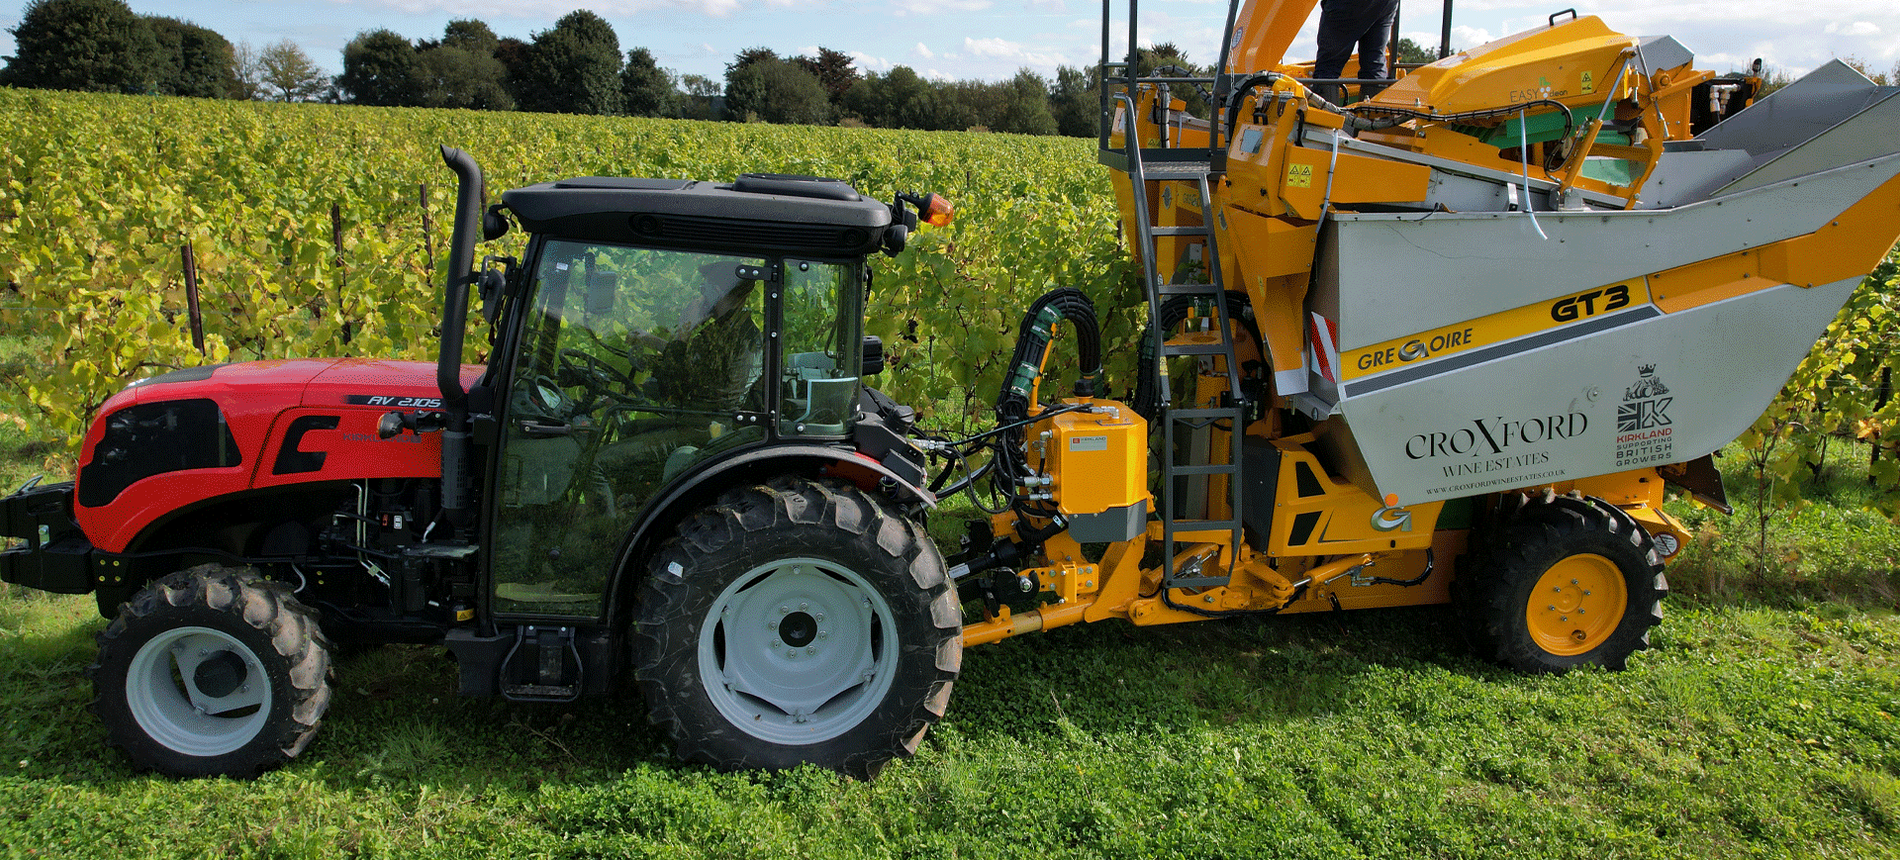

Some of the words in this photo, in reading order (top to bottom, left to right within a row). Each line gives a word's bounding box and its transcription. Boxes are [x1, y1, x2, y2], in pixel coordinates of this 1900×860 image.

[1510, 88, 1539, 103] EASY
[1550, 285, 1630, 323] GT3
[1357, 328, 1473, 370] GREGOIRE
[367, 396, 395, 405] AV
[398, 398, 441, 407] 2.105
[1405, 412, 1588, 460] CROXFORD
[1616, 428, 1672, 443] KIRKLAND
[1616, 436, 1672, 451] SUPPORTING
[1616, 443, 1672, 459] BRITISH
[1616, 452, 1671, 466] GROWERS
[1443, 461, 1482, 478] WINE
[1485, 451, 1550, 472] ESTATES
[1426, 469, 1566, 495] WWW.CROXFORDWINEESTATES.CO.UK
